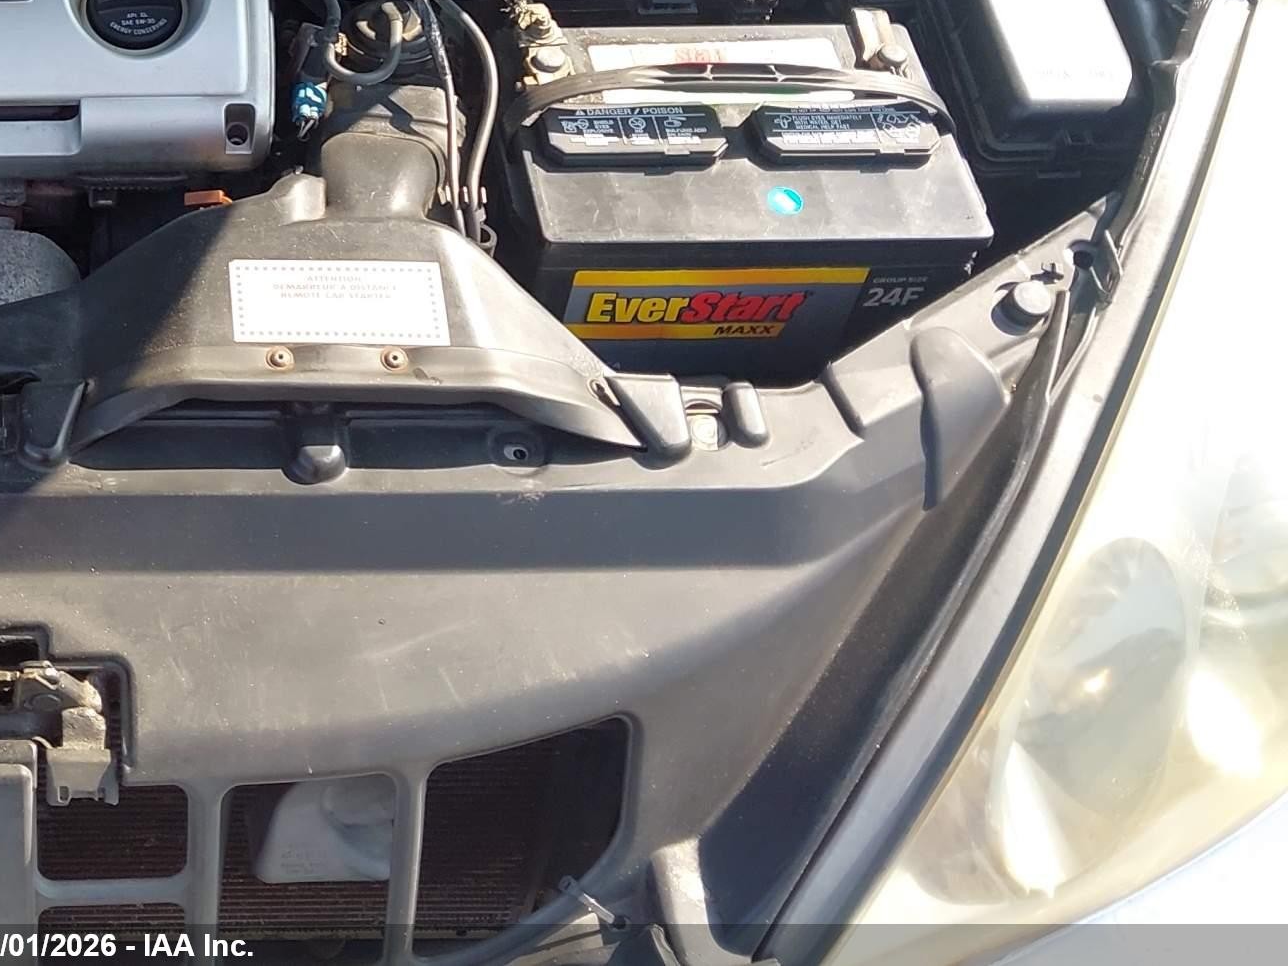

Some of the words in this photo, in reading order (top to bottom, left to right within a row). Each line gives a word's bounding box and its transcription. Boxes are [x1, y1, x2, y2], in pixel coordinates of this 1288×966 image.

[587, 108, 632, 116] DANGER
[644, 106, 683, 115] POISON
[863, 286, 925, 307] 24F
[585, 290, 806, 324] EverStart
[713, 324, 776, 336] MAXX
